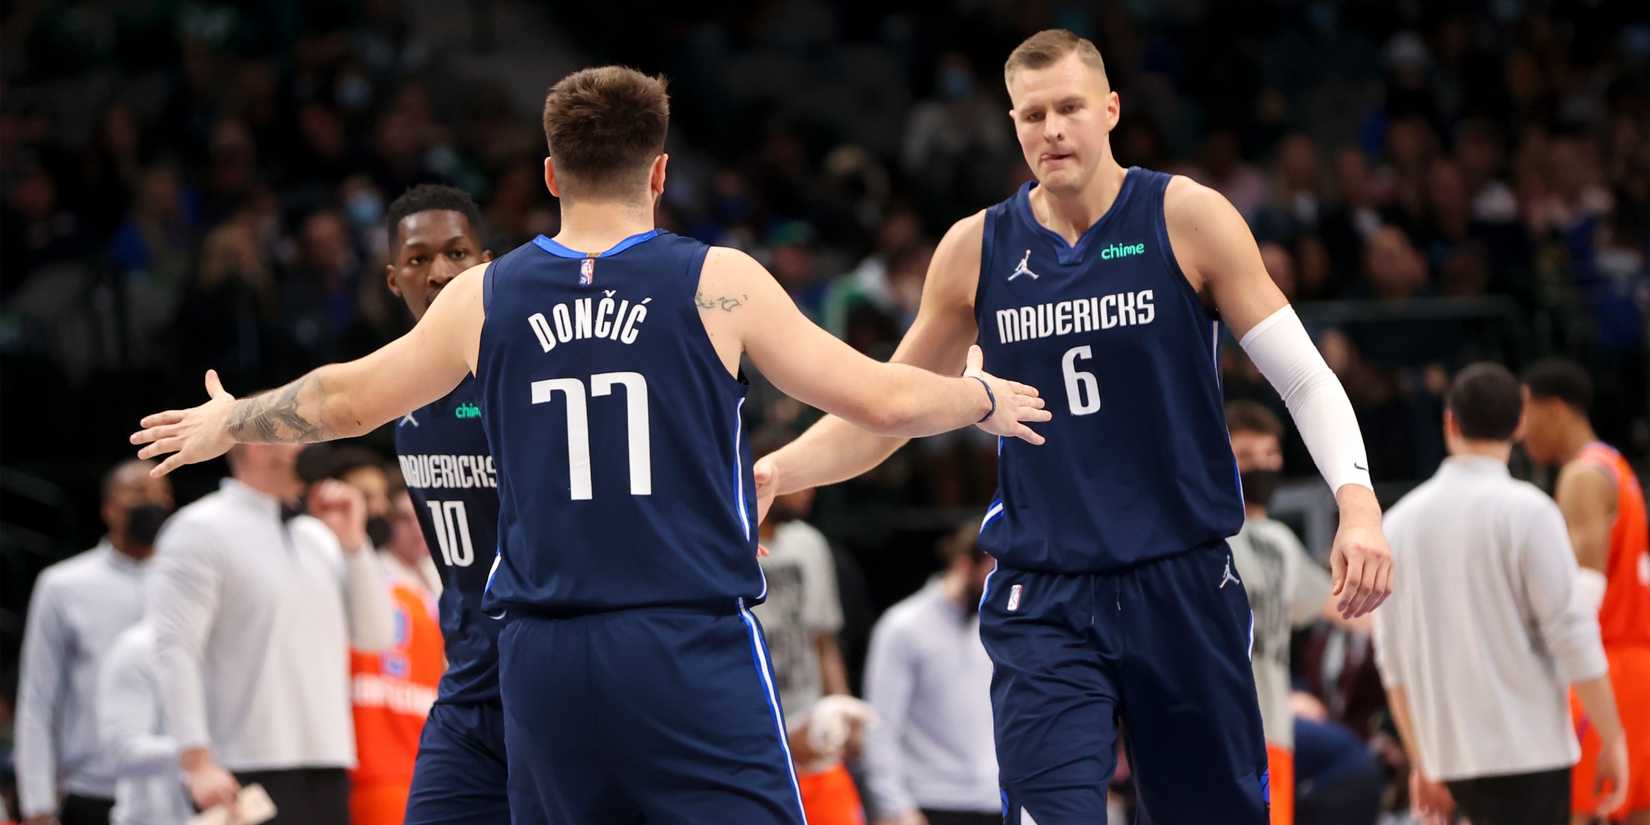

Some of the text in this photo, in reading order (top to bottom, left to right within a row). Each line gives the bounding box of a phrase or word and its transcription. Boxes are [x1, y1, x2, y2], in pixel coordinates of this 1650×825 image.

[1101, 242, 1145, 260] chime
[528, 290, 653, 353] DONČIĆ
[997, 290, 1155, 344] MAVERICKS
[1061, 345, 1101, 416] 6
[530, 371, 652, 501] 77
[426, 501, 475, 567] 10
